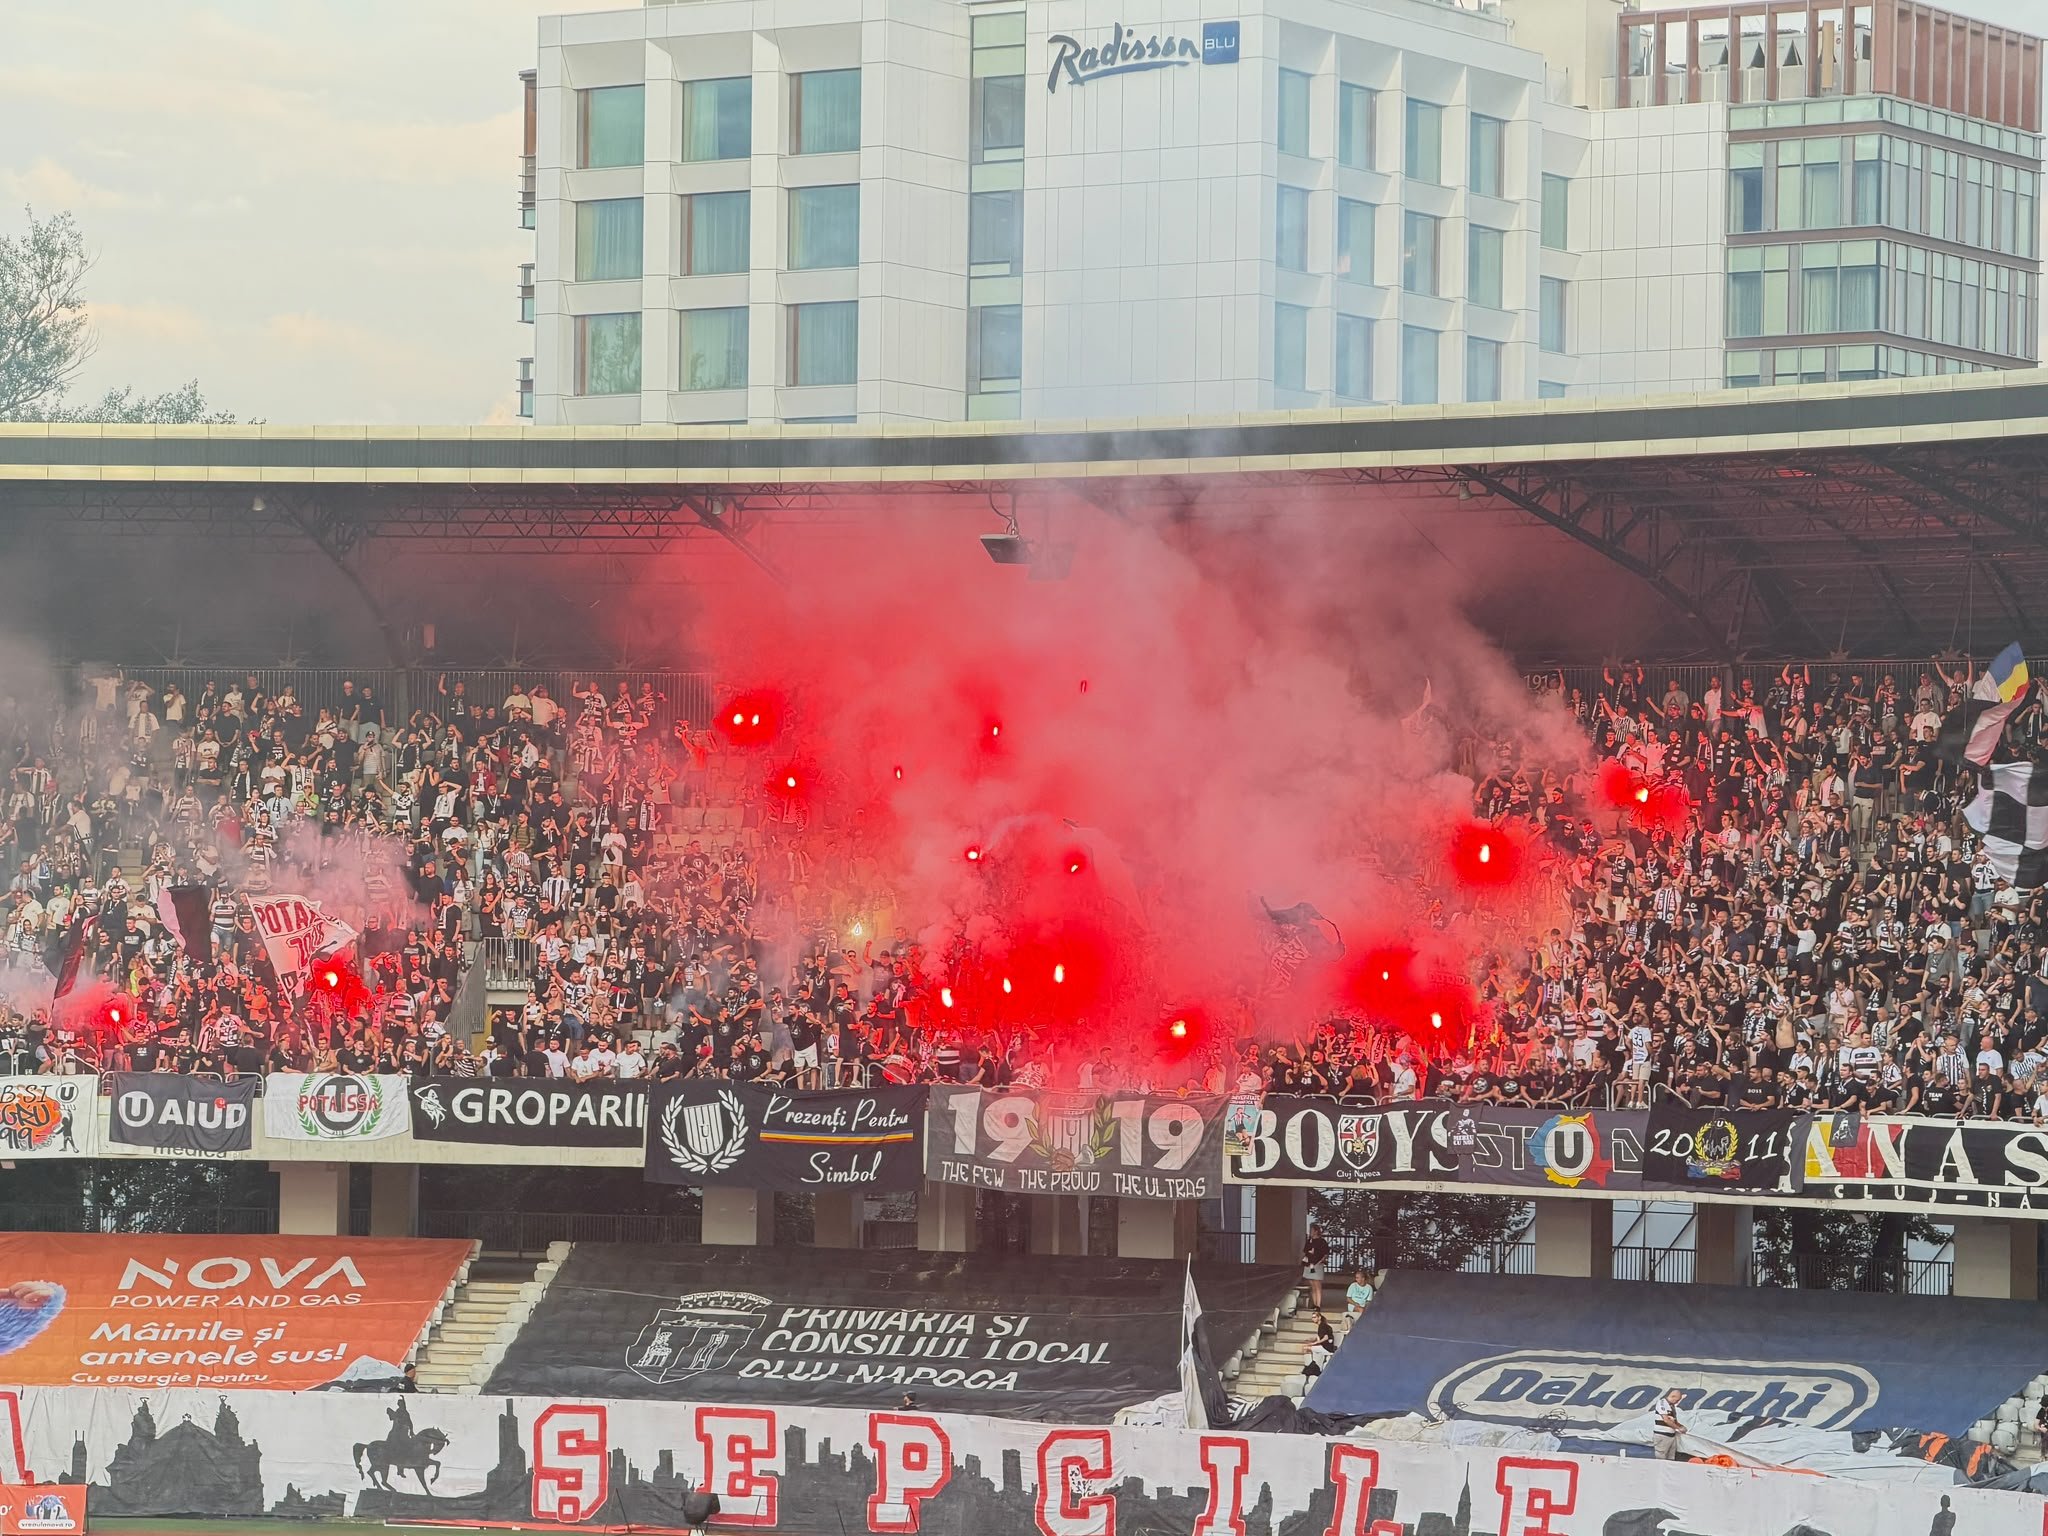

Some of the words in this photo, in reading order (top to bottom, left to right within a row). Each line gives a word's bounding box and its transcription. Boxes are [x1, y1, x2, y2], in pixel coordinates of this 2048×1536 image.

[1047, 22, 1200, 94] Radisson
[1204, 36, 1236, 50] BLU
[130, 1099, 148, 1122] U
[158, 1099, 247, 1130] AIUD
[298, 1092, 379, 1113] POTAISSA
[451, 1088, 644, 1128] GROPARII
[763, 1092, 847, 1133] Prezenți
[947, 1091, 1036, 1164] 19
[1108, 1099, 1206, 1171] 19
[800, 1150, 882, 1183] Simbol
[942, 1161, 970, 1182] THE
[972, 1166, 1004, 1187] FEW
[1018, 1169, 1047, 1190] THE
[1050, 1169, 1100, 1192] PROUD
[1112, 1172, 1141, 1195] THE
[1145, 1177, 1206, 1198] ULTRAS
[1336, 1169, 1351, 1180] Cluj
[1354, 1169, 1381, 1180] Napoca
[117, 1256, 366, 1290] NOVA
[110, 1294, 219, 1308] POWER
[225, 1294, 291, 1308] AND
[299, 1292, 362, 1306] GAS
[89, 1321, 244, 1341] Mâinile
[253, 1321, 288, 1348] și
[761, 1329, 971, 1359] CONSILIUL
[983, 1338, 1112, 1365] LOCAL
[80, 1345, 259, 1366] antenele
[267, 1342, 348, 1363] sus!
[71, 1372, 101, 1384] Cu
[106, 1371, 192, 1387] energie
[195, 1372, 268, 1386] pentru
[738, 1358, 840, 1382] CLUJ
[846, 1363, 1019, 1391] NAPOCA
